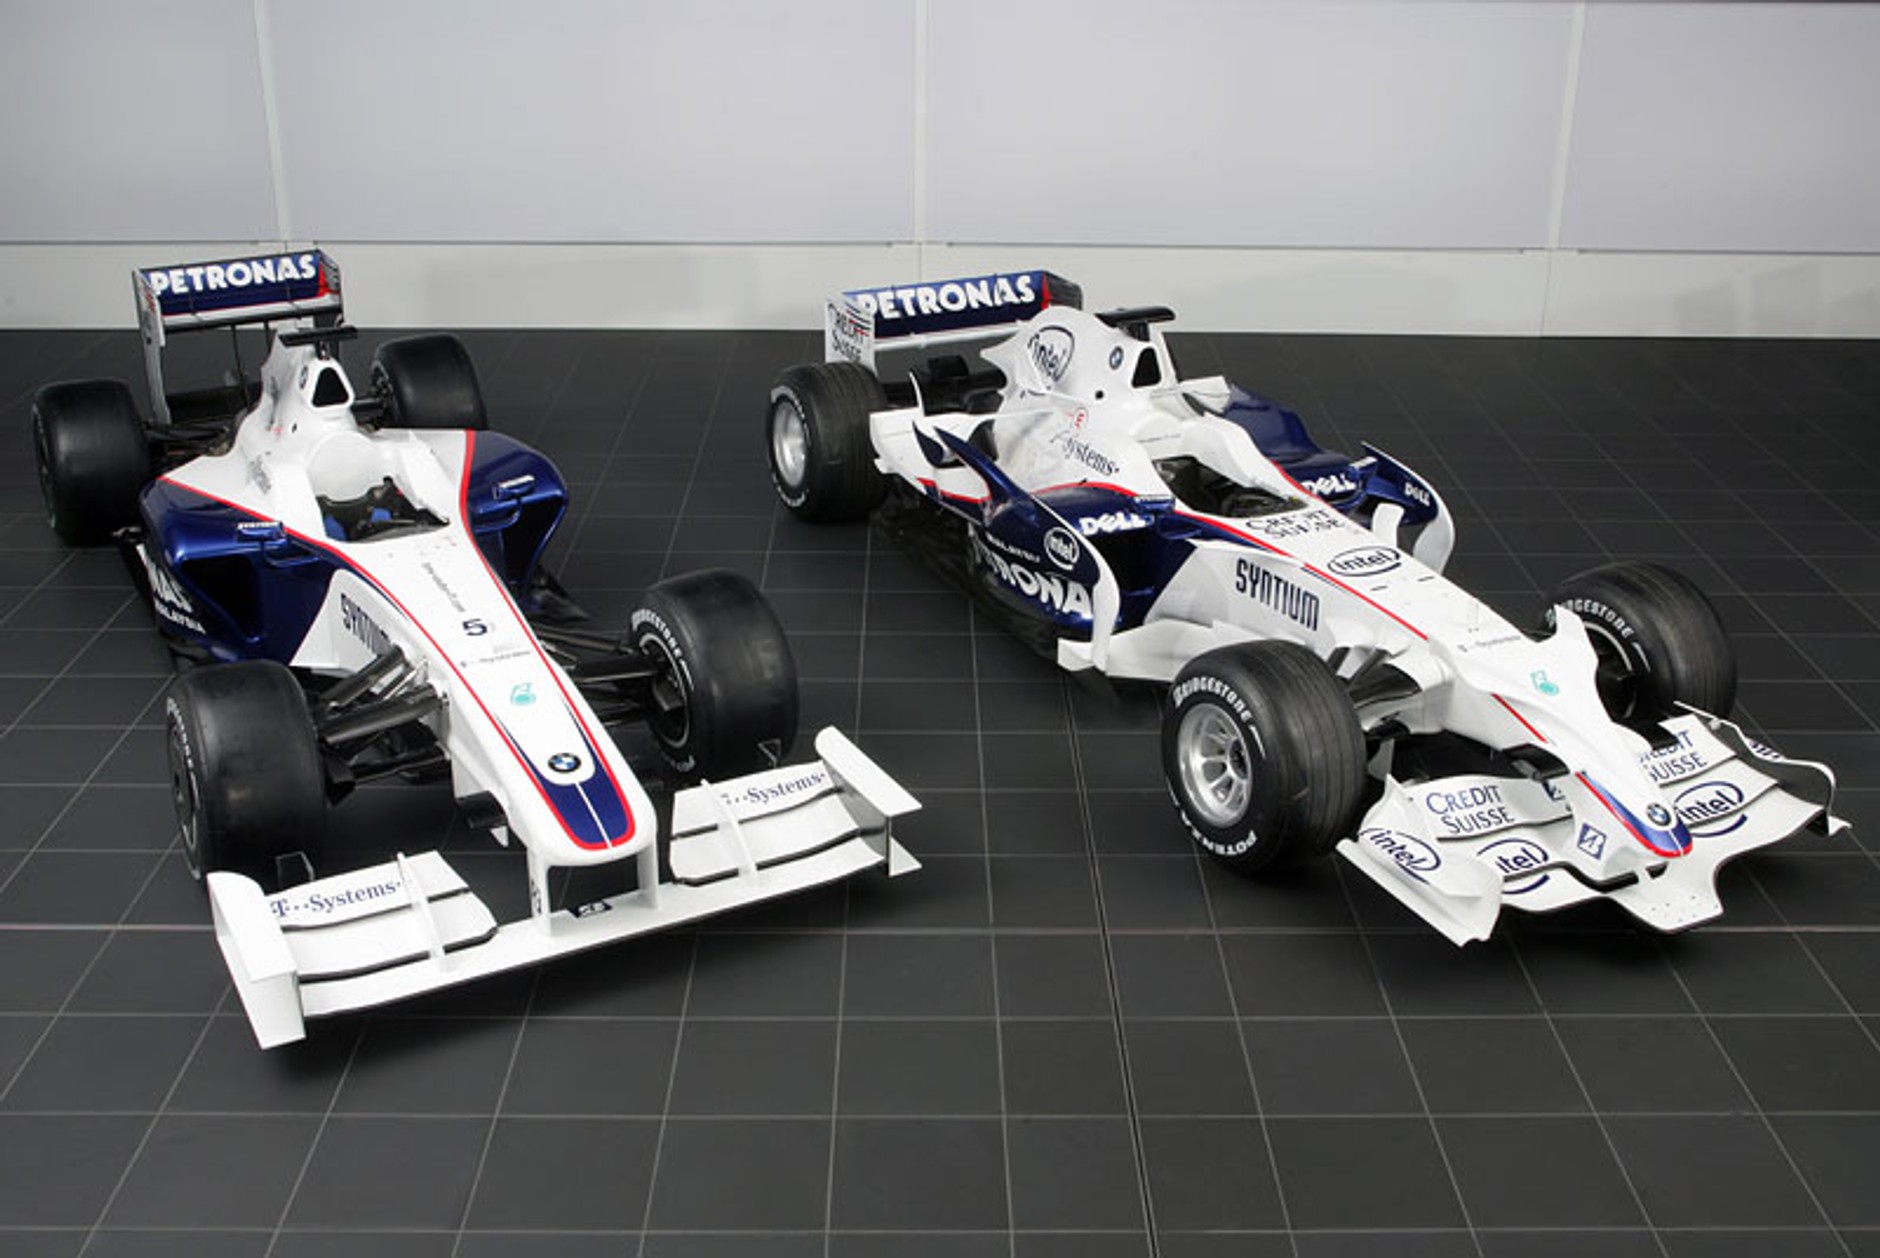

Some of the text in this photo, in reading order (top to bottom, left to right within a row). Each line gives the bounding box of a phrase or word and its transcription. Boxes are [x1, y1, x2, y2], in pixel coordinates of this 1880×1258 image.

[150, 254, 316, 295] PETRONAS
[857, 274, 1036, 322] PETRONAS
[1301, 473, 1357, 496] DELL
[1078, 511, 1154, 537] DELL
[1236, 558, 1320, 632] SYNTIUM
[462, 618, 488, 637] 5
[1426, 784, 1504, 815] CREDIT
[1440, 805, 1515, 835] SUISSE
[1370, 828, 1430, 871] intel
